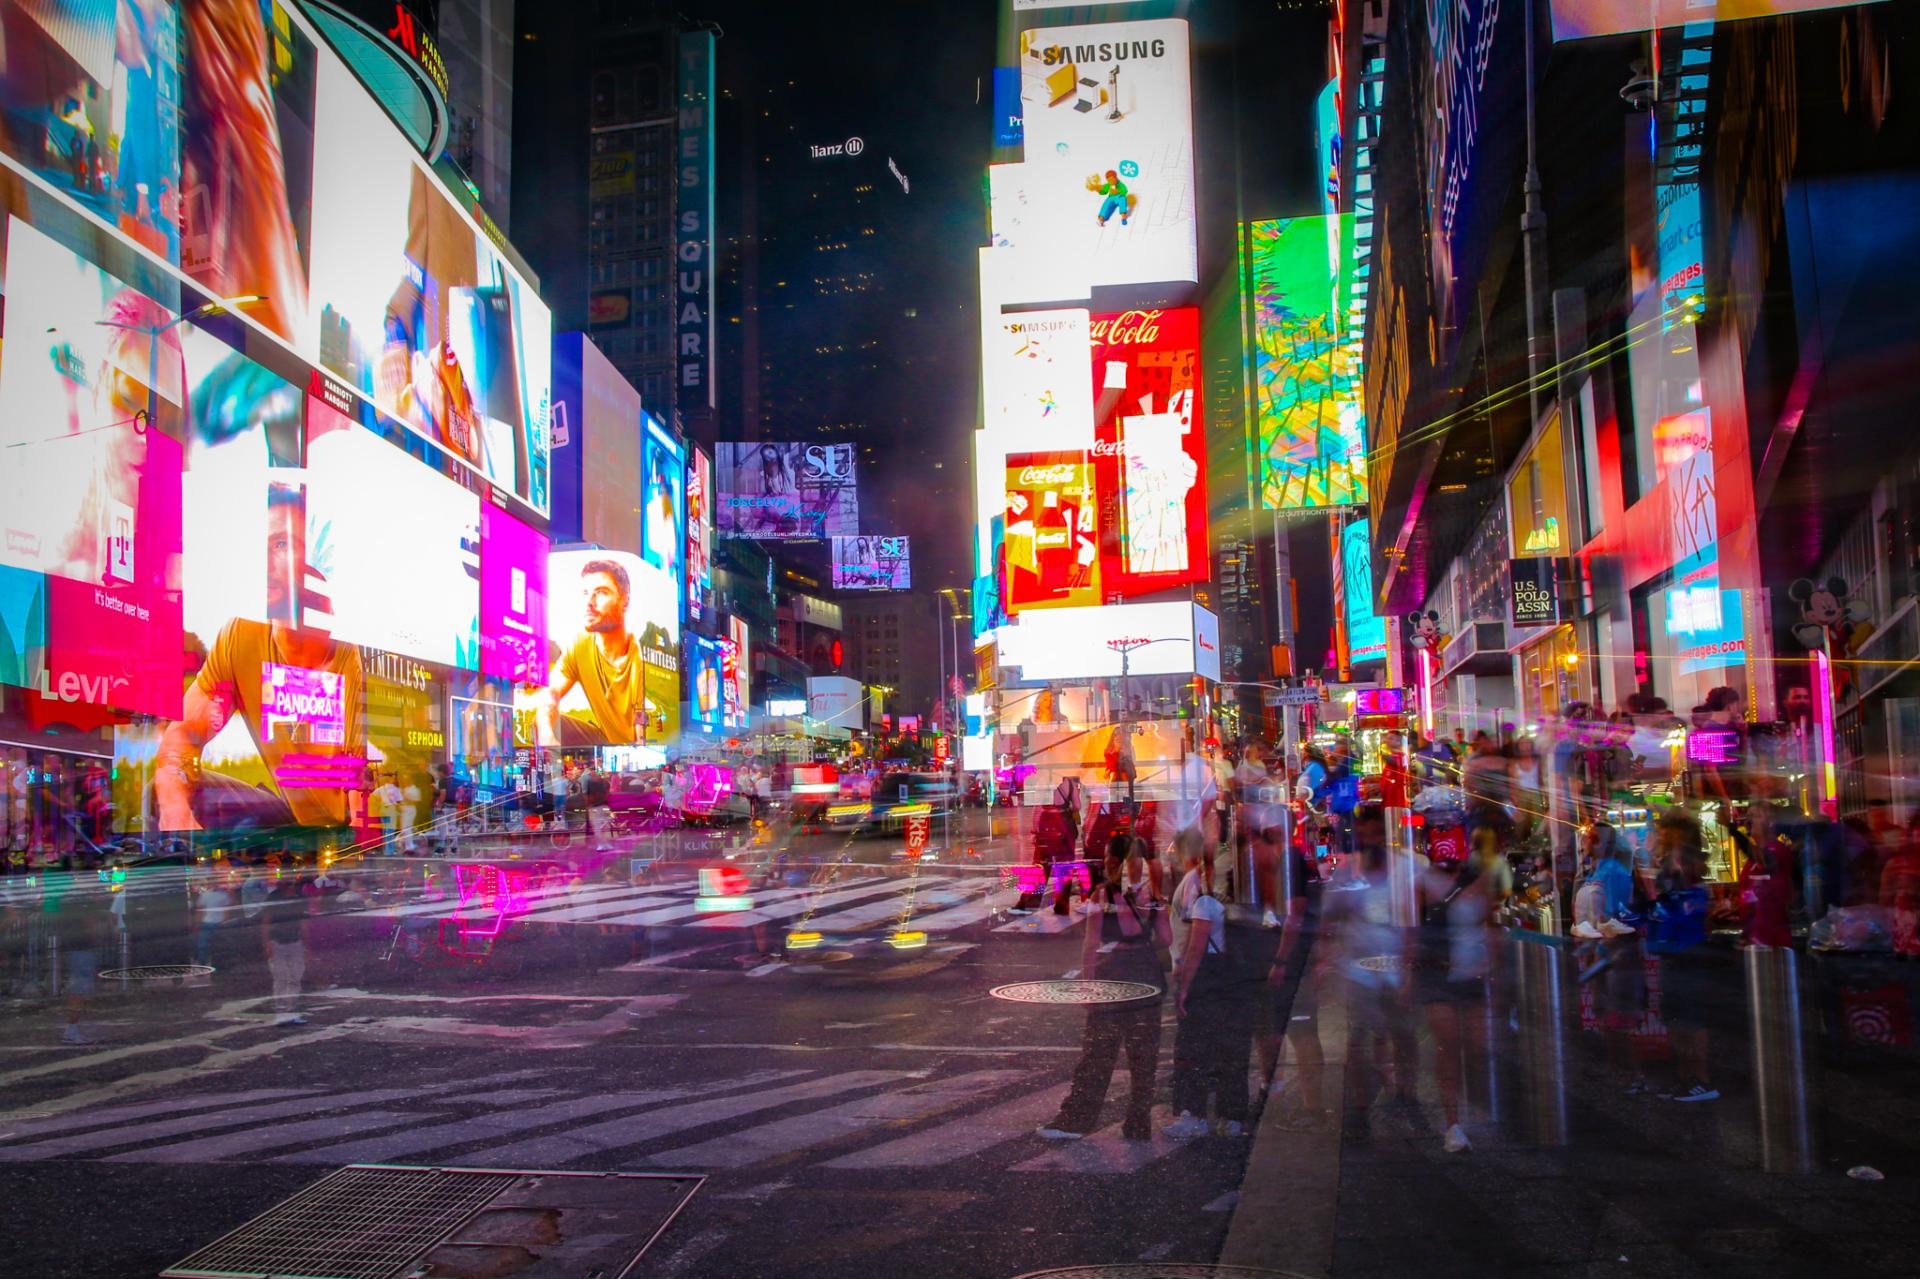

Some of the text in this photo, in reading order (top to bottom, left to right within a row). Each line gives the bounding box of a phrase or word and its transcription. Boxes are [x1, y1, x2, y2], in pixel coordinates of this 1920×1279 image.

[1043, 39, 1165, 66] SAMSUNG
[679, 51, 702, 387] TIMES SQUARE
[324, 379, 352, 403] MARRIOTT
[803, 444, 852, 478] SU
[1515, 581, 1538, 592] U.S.
[1515, 590, 1549, 603] POLO
[94, 588, 150, 622] It's better over here
[1516, 601, 1553, 614] ASSN.
[642, 645, 677, 672] LIMITLESS
[276, 691, 334, 717] PANDORA
[408, 731, 444, 747] SEPHORA
